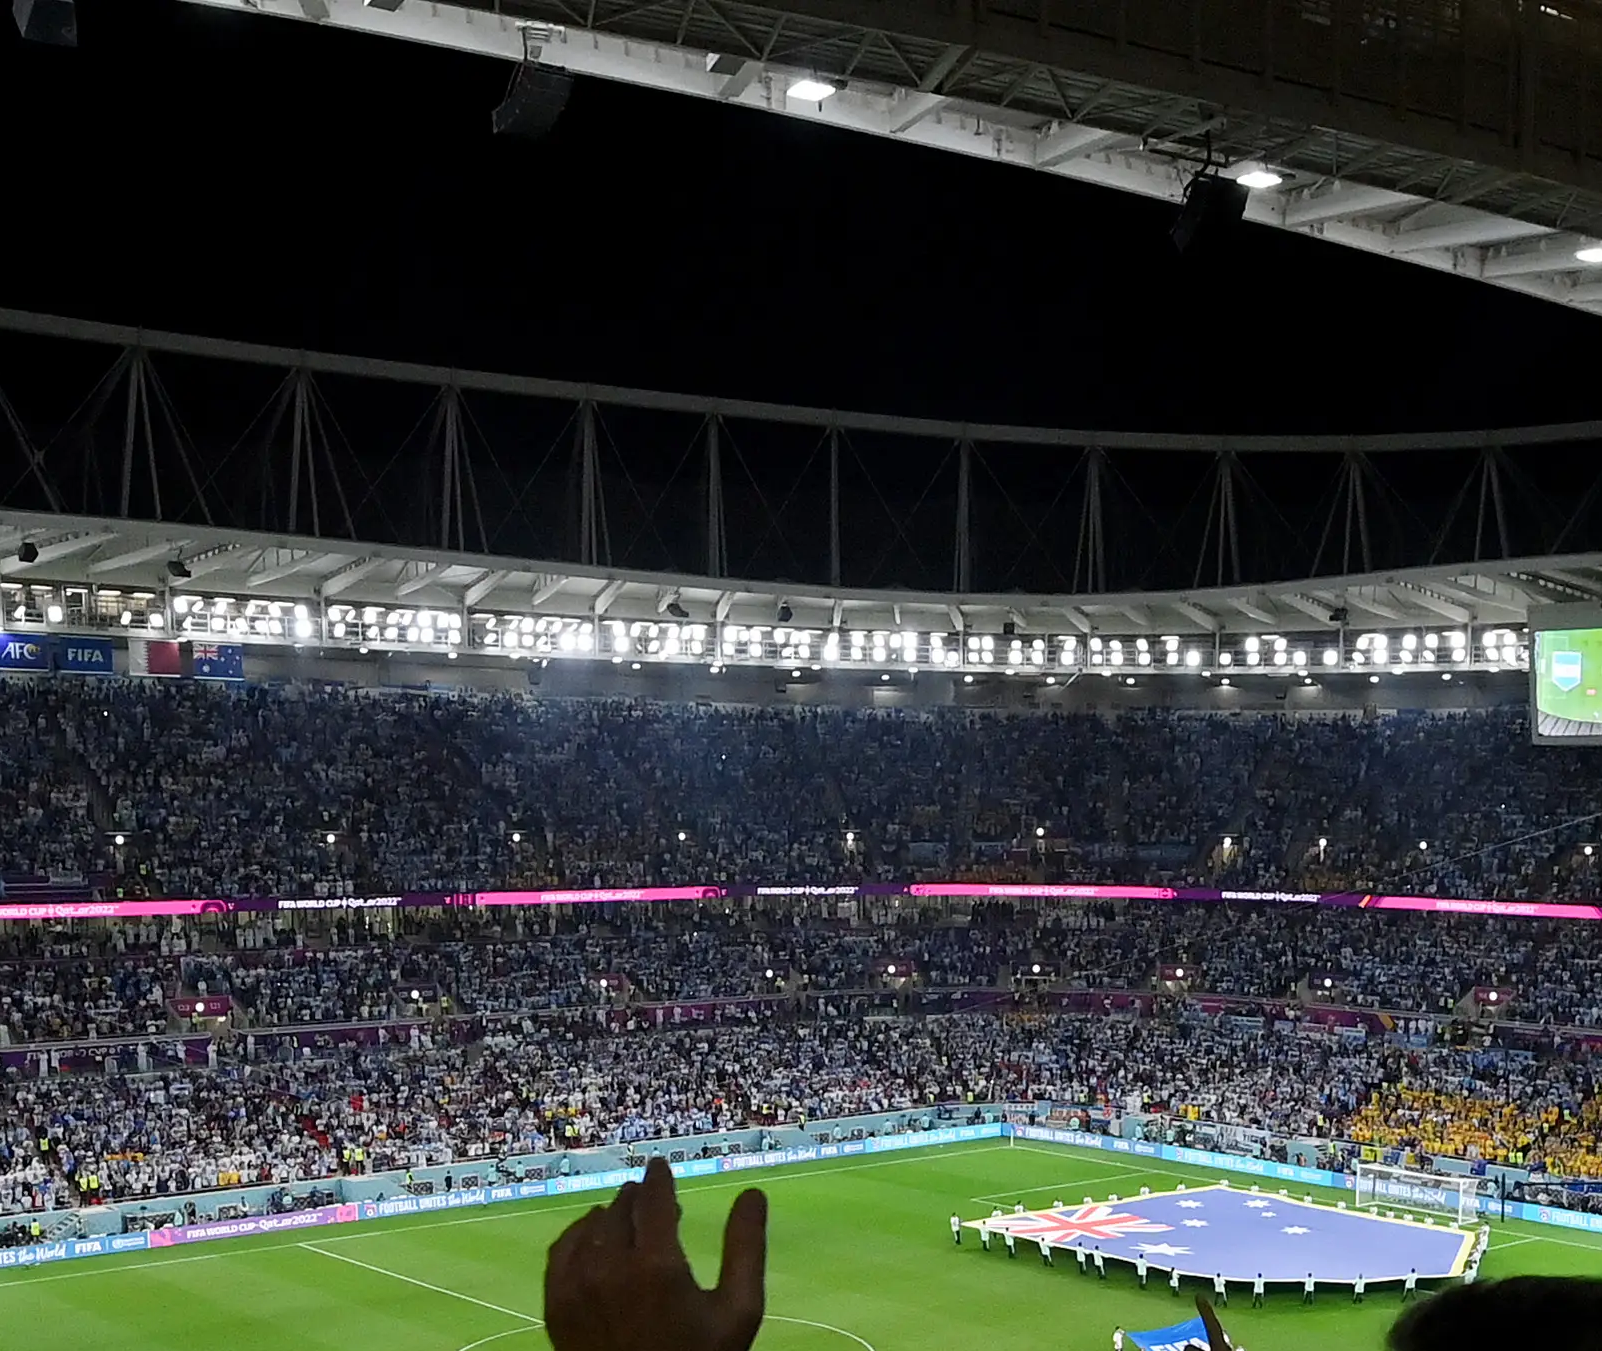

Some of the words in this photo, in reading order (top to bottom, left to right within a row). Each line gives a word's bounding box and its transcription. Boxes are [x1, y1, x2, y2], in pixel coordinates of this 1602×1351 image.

[1, 641, 39, 661] AFC
[67, 648, 105, 664] FIFA
[16, 1248, 35, 1264] the
[35, 1243, 66, 1261] World
[74, 1241, 103, 1255] FIFA
